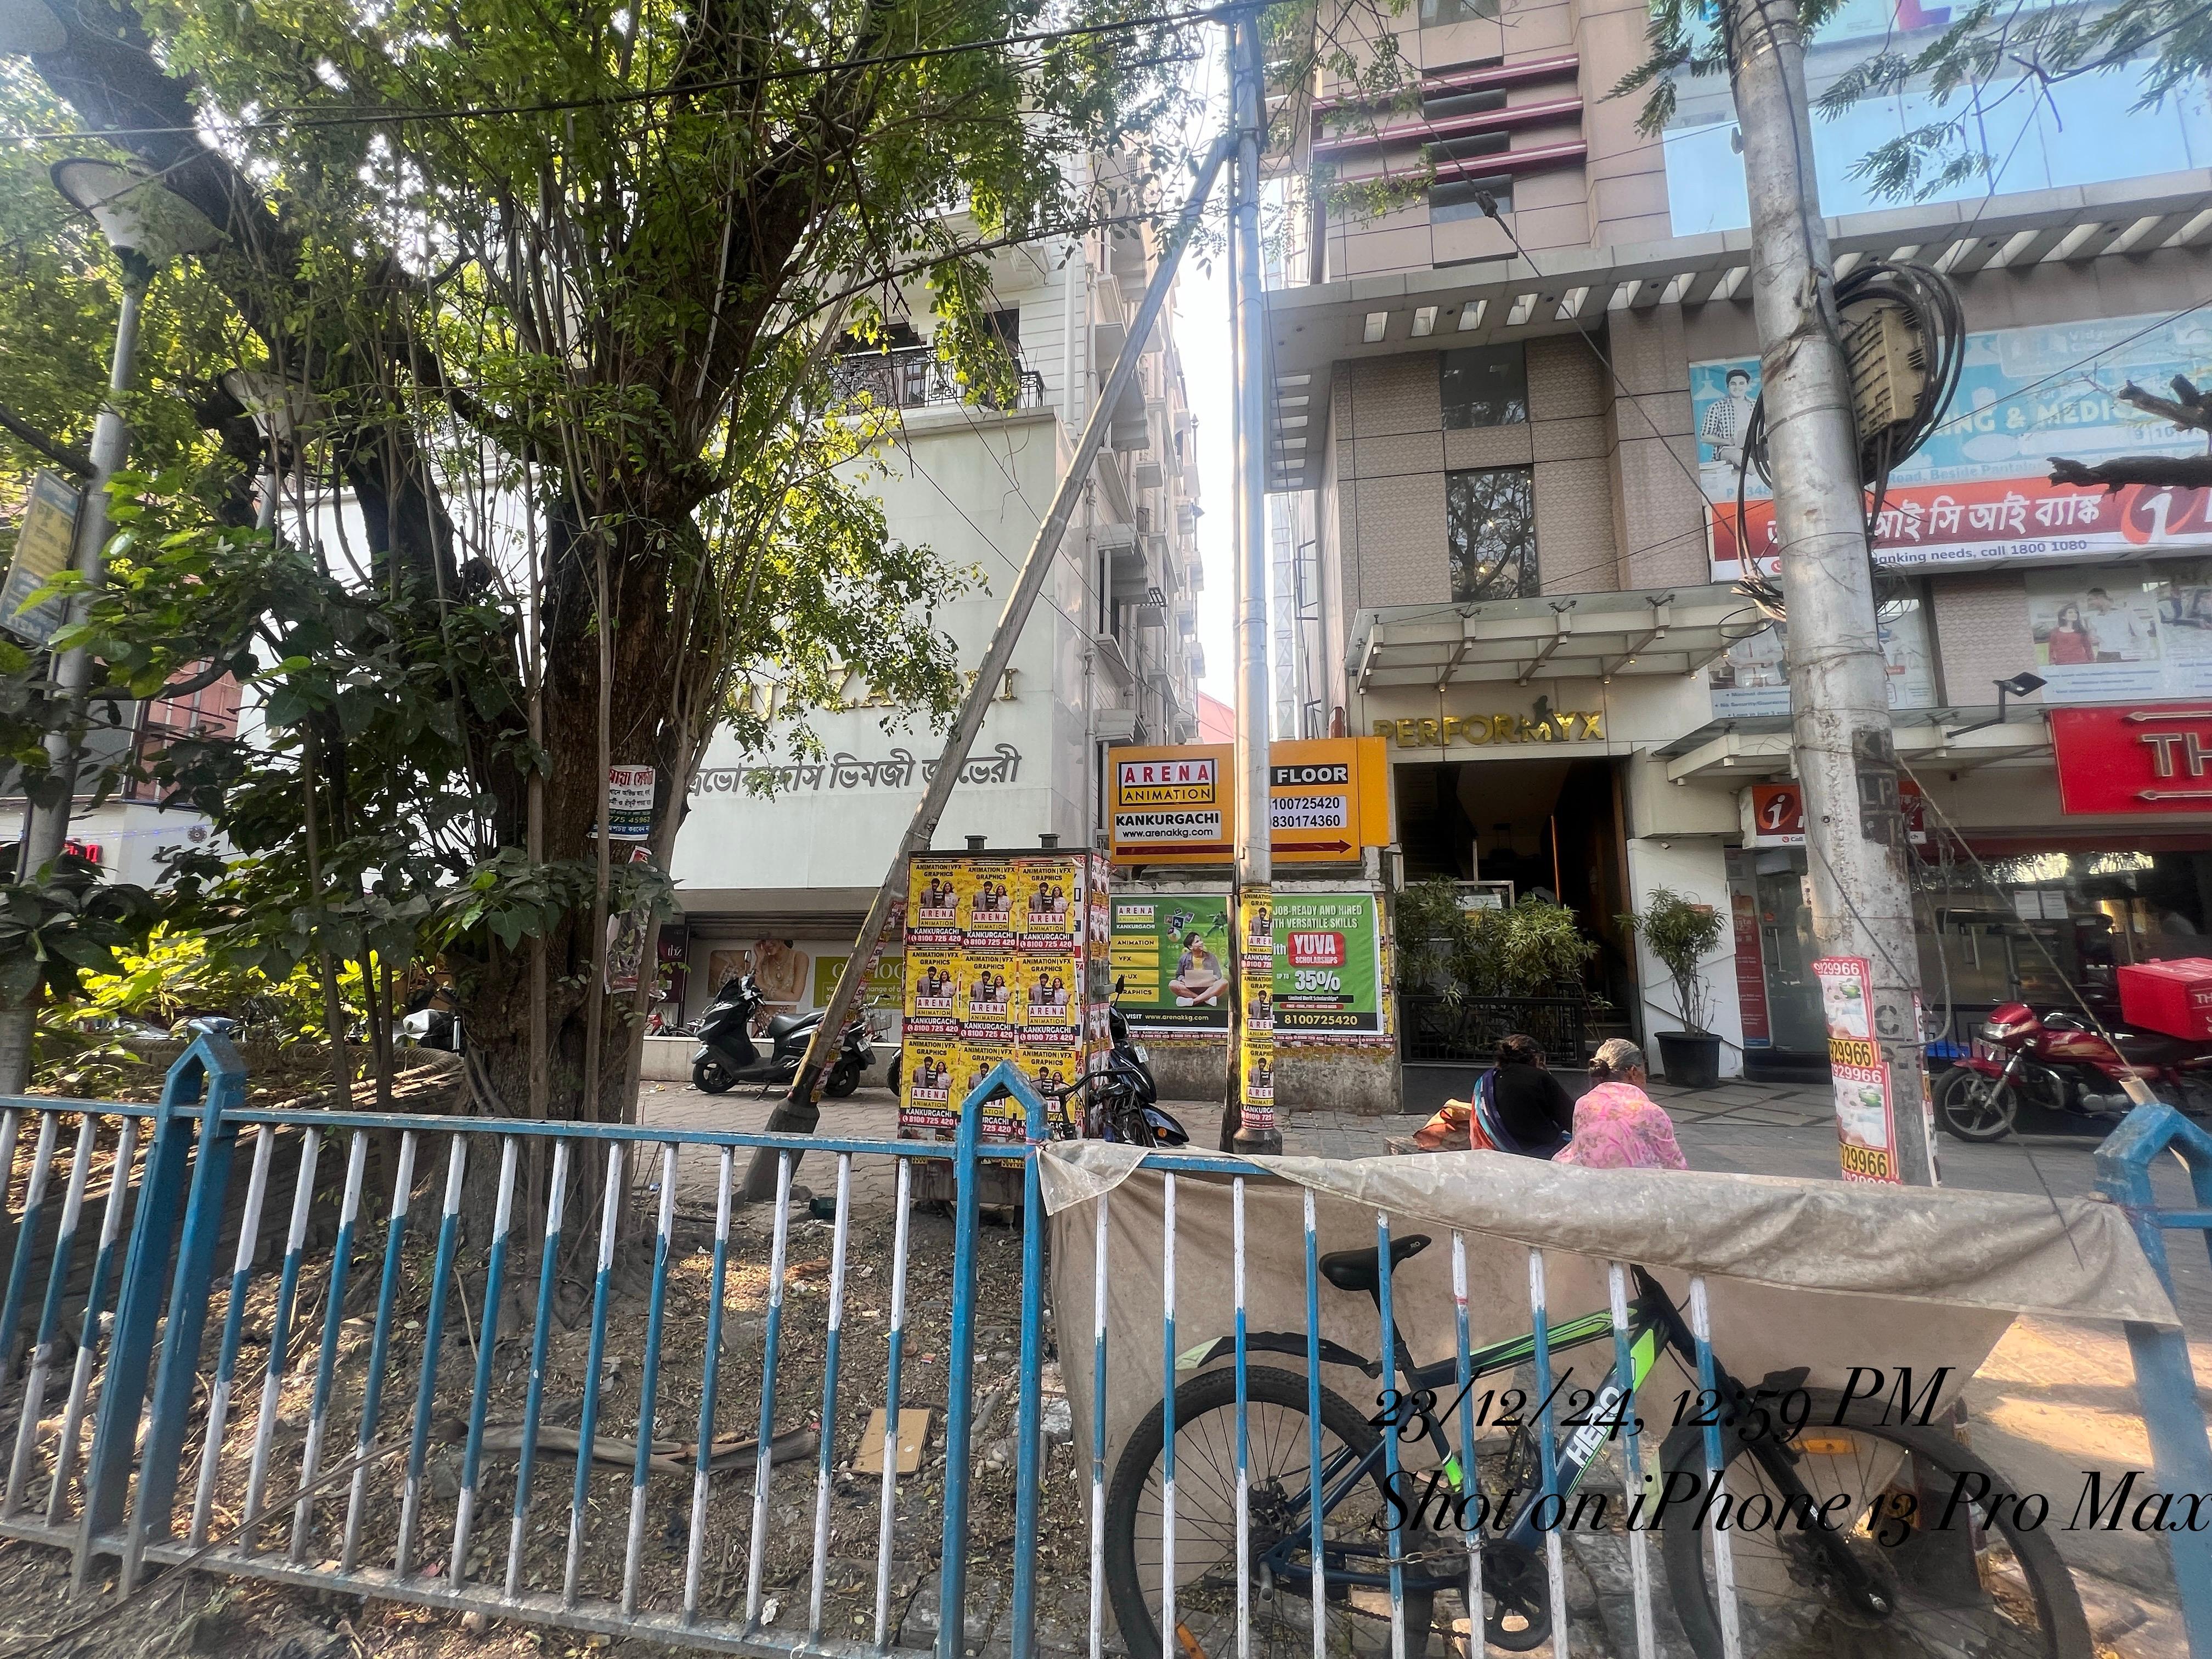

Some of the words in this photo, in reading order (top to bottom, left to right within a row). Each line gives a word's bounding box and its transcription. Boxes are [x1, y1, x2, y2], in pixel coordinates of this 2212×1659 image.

[1968, 491, 2030, 535] আই
[1930, 548, 1977, 560] needs,
[1980, 544, 2006, 557] call
[2011, 541, 2046, 555] 1800
[2051, 539, 2087, 551] 1080
[1124, 764, 1209, 783] ARENA
[1277, 767, 1347, 783] FLOOR
[1124, 788, 1210, 801] ANIMATION
[1272, 797, 1340, 810] 100725420
[1116, 812, 1219, 826] KANKURGACHI
[1272, 815, 1340, 827] 830174360
[1122, 828, 1213, 838] www.arenakkg.com
[1273, 905, 1317, 916] JOB-READY
[1319, 905, 1336, 916] AND
[1339, 905, 1362, 916] HIRED
[1273, 918, 1285, 928] ITH
[1287, 918, 1328, 928] VERSATILE
[1330, 918, 1358, 928] SKILLS
[1273, 943, 1286, 955] ith
[1294, 934, 1336, 955] YUVA
[1295, 956, 1338, 964] SCHOLARSHIPS
[1294, 970, 1340, 991] 35%
[971, 1003, 1005, 1012] ARENA
[1284, 1014, 1358, 1025] 8100725420
[964, 1023, 1011, 1031] KANKURGACHI
[913, 1089, 946, 1099] ARENA
[906, 1108, 952, 1118] KANKURGACHI
[909, 1115, 926, 1124] 8100
[940, 1117, 953, 1125] 420
[1566, 1386, 1621, 1469] HERO
